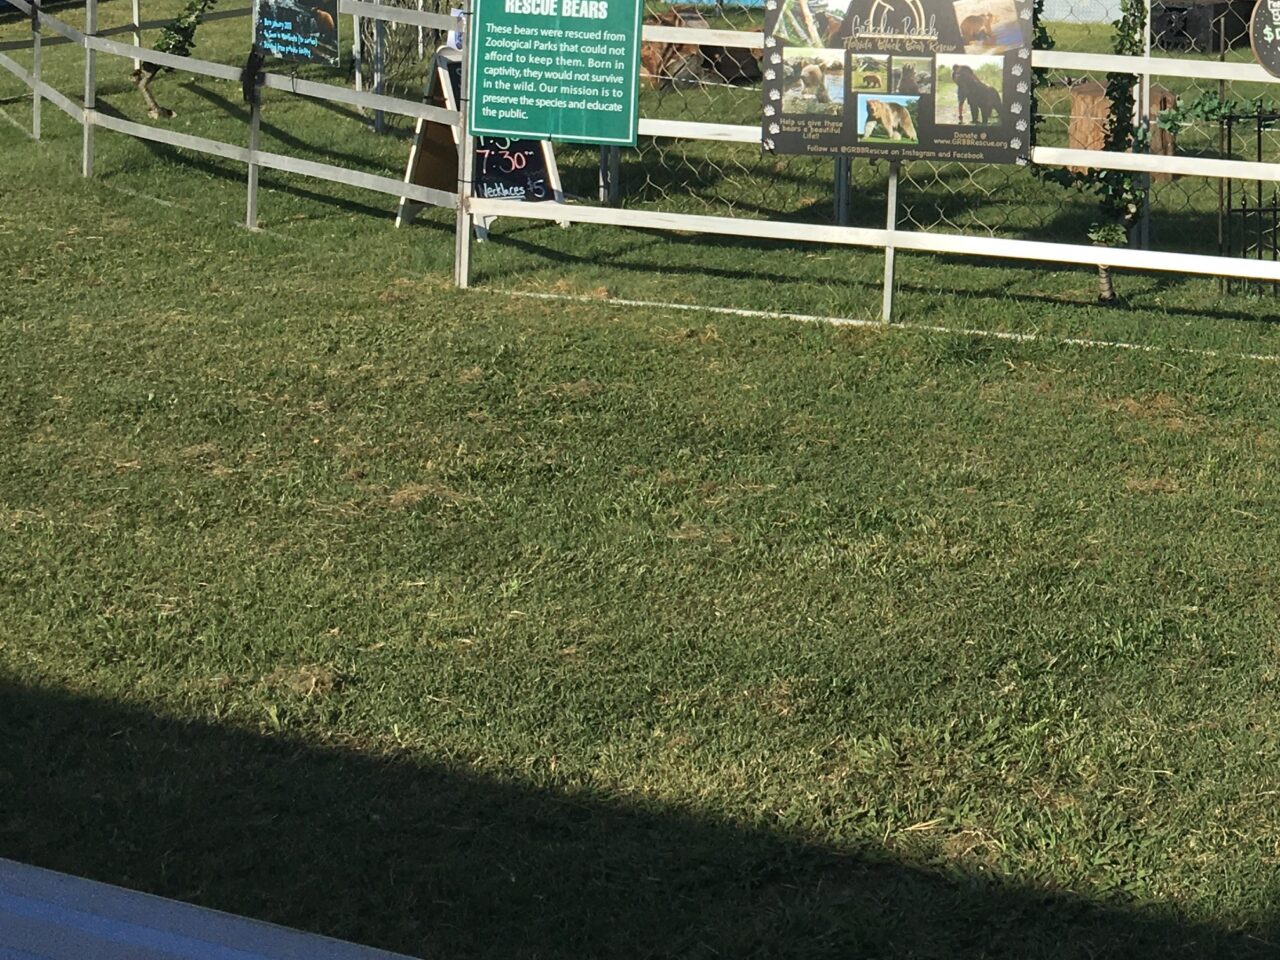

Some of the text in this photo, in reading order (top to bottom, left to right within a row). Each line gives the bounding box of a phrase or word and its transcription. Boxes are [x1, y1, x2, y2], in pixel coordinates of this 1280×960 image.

[562, 0, 608, 19] BEARS
[486, 23, 626, 41] These bears were rescued from
[852, 14, 939, 38] Grizzly Ranch
[485, 37, 625, 56] Zoological Parks that could not
[484, 52, 624, 70] afford to keep them. Born in
[484, 66, 624, 84] captivity, they would not survive
[483, 79, 623, 98] in the wild. Our mission is to
[482, 95, 623, 112] preserve the species and educate
[482, 107, 529, 120] the public.
[954, 131, 978, 139] Donate
[807, 144, 828, 152] Follow
[902, 148, 936, 158] Instagram
[953, 151, 984, 160] Facebook
